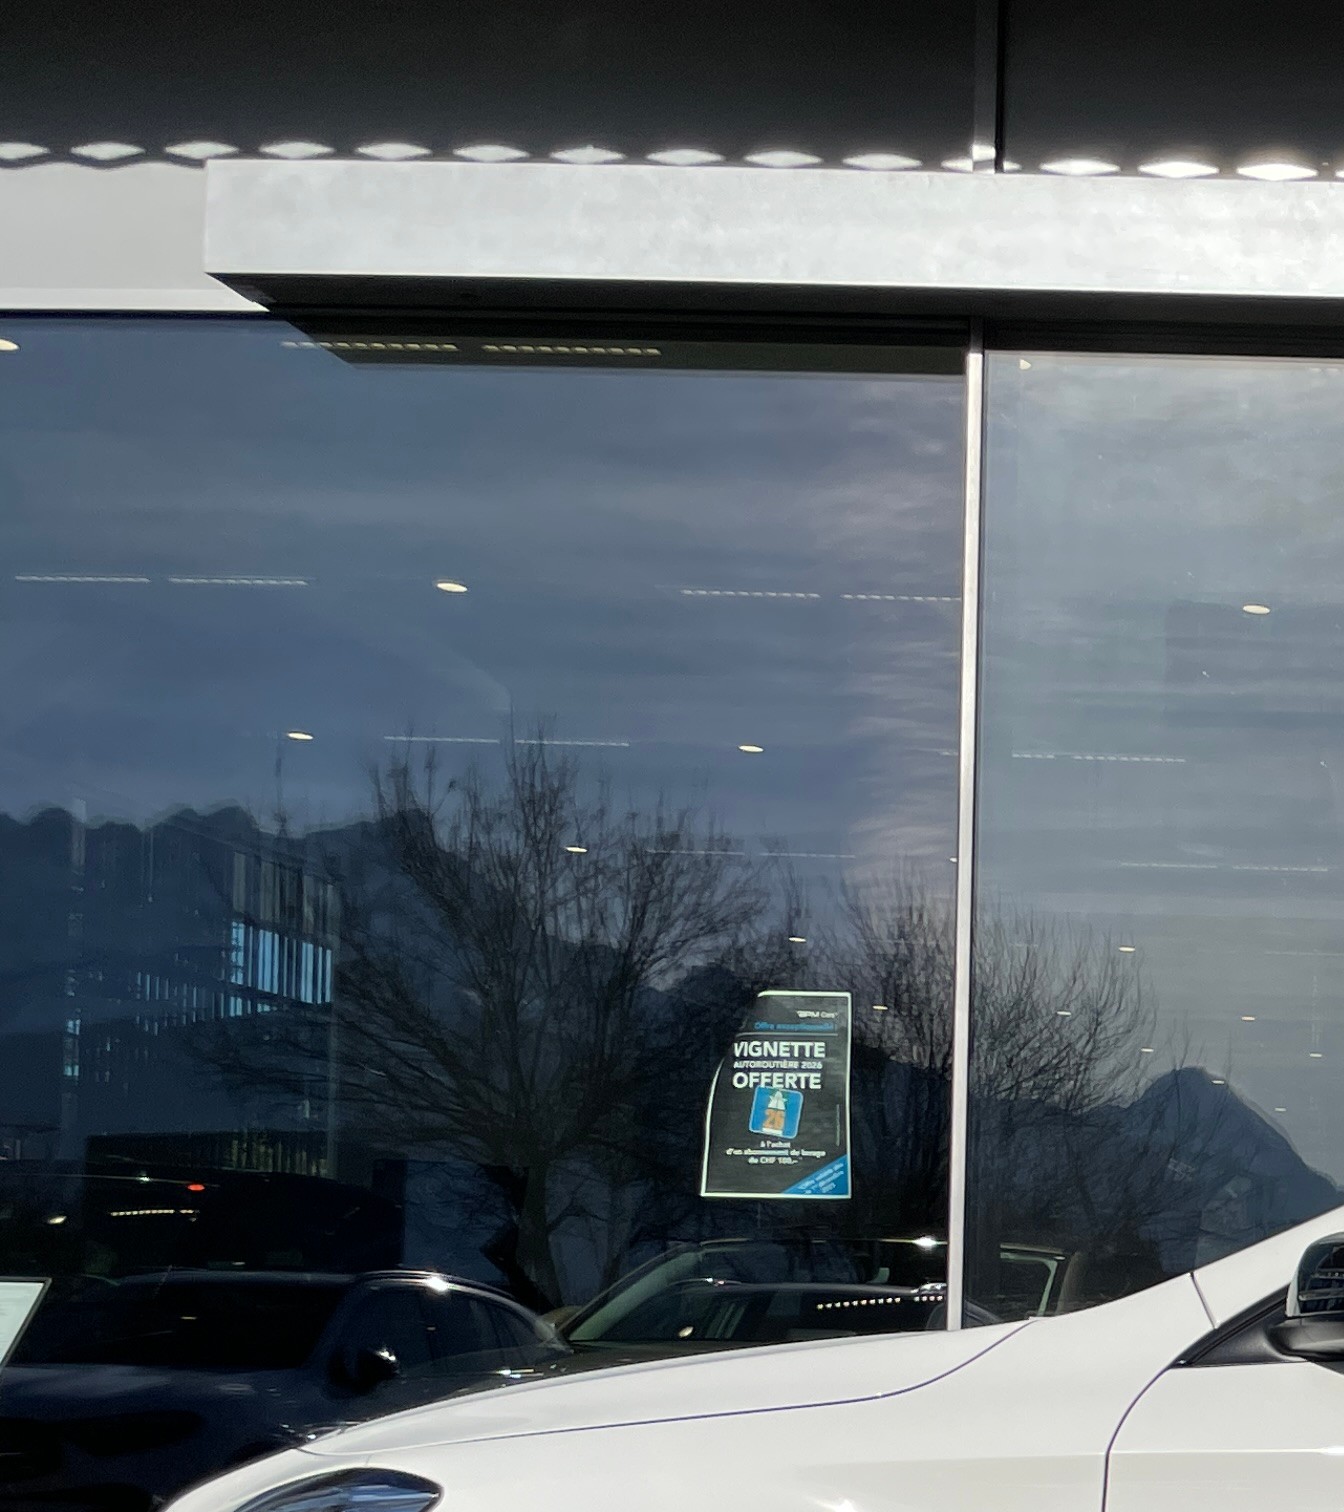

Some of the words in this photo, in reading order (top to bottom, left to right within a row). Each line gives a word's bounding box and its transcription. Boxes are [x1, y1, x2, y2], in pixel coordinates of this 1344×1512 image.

[733, 1041, 826, 1058] VIGNETTE
[801, 1061, 823, 1069] 2026
[732, 1071, 822, 1090] OFFERTE
